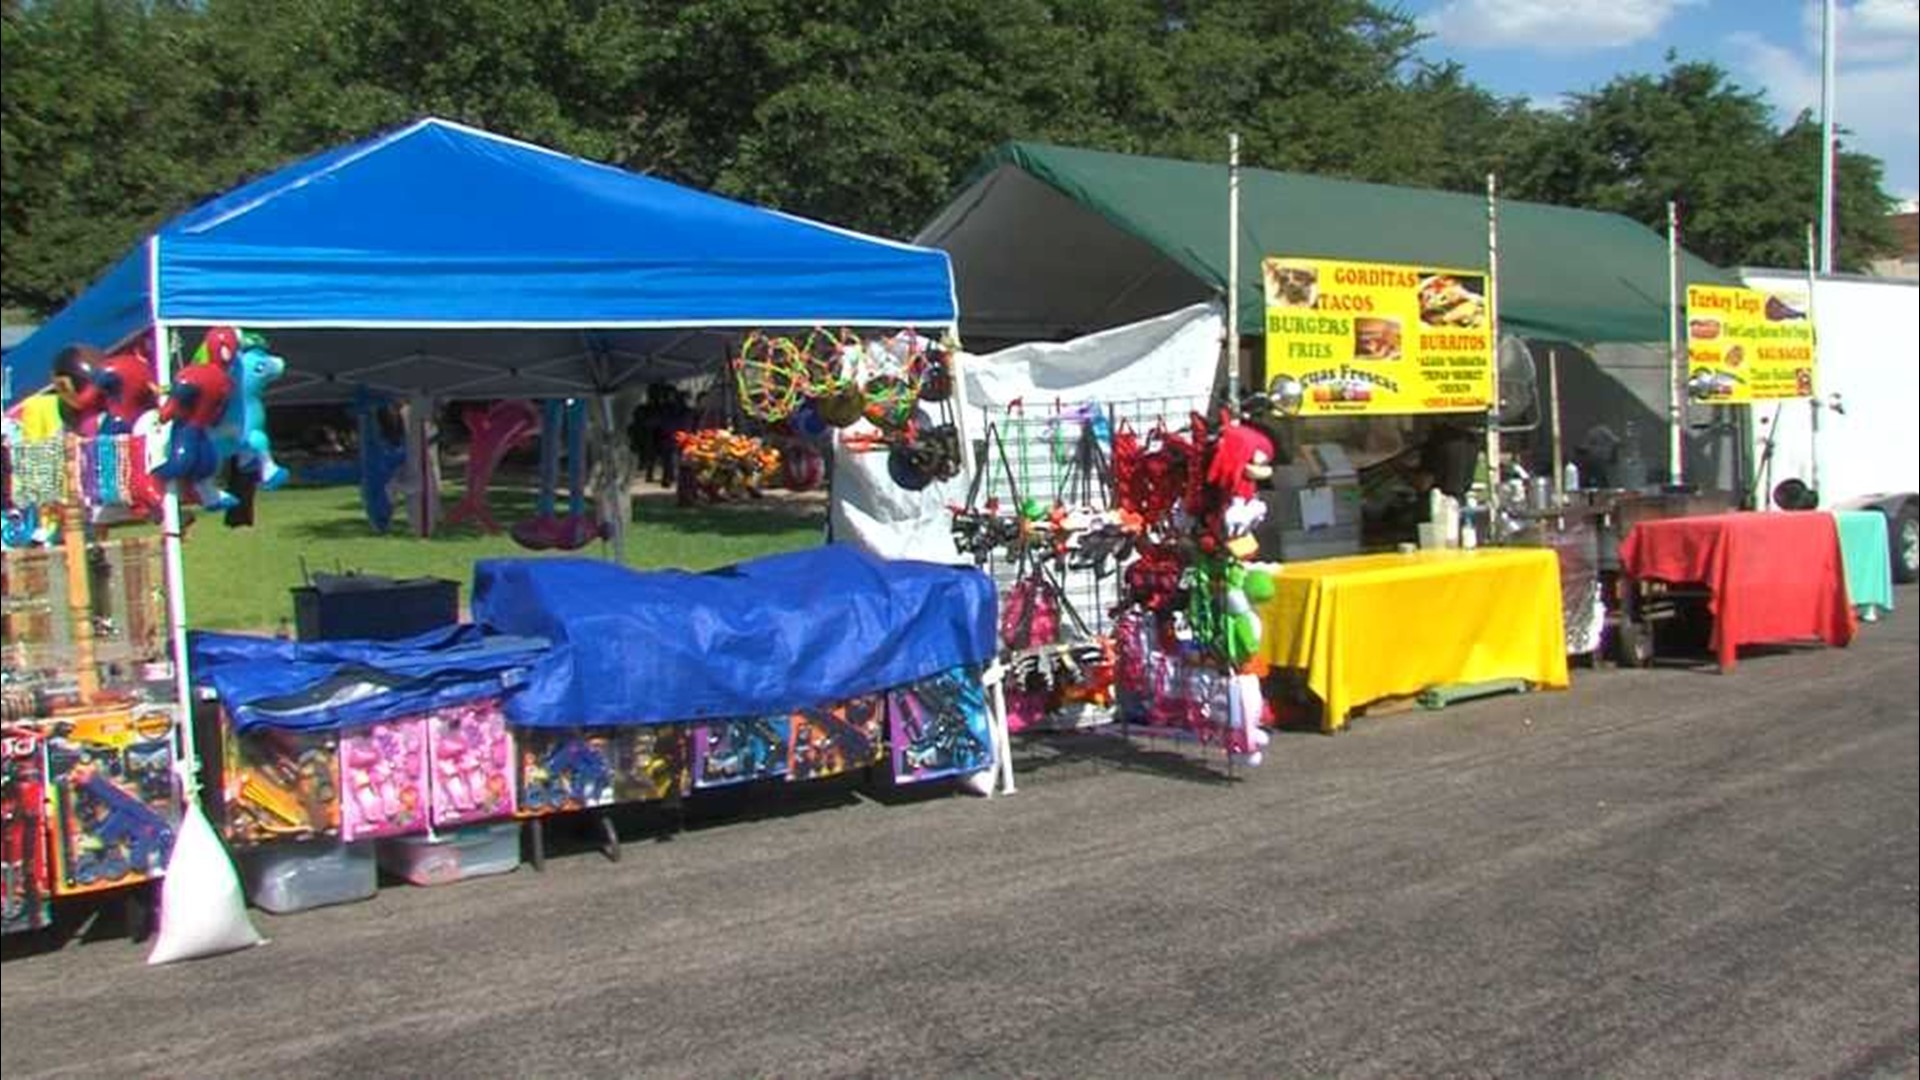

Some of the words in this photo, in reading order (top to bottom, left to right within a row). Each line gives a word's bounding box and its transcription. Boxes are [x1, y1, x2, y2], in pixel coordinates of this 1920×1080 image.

[1335, 267, 1417, 288] GORDITAS
[1318, 293, 1375, 312] TACOS
[1690, 289, 1731, 313] Turkey
[1735, 291, 1760, 314] Legs
[1269, 315, 1350, 336] BURGERS
[1288, 342, 1333, 359] FRIES
[1420, 334, 1486, 351] BURRITOS
